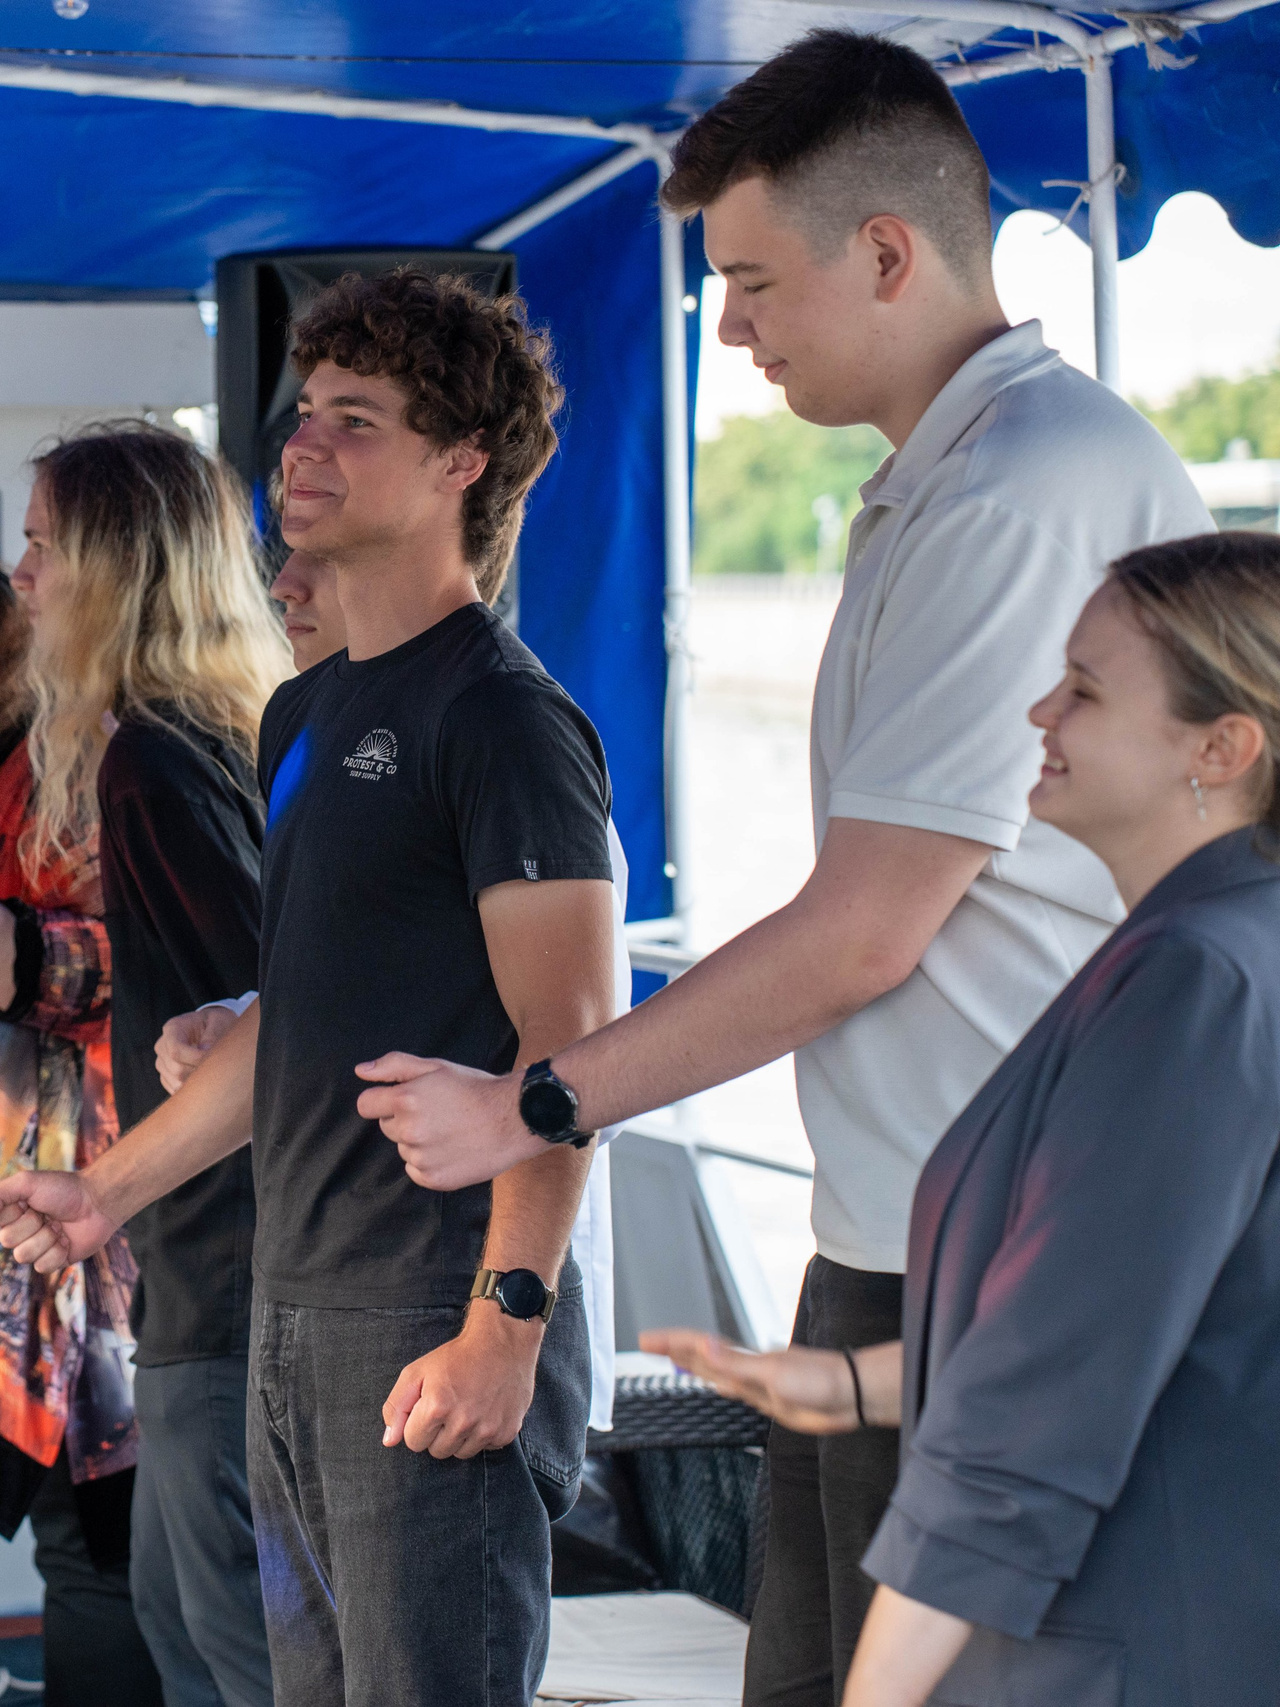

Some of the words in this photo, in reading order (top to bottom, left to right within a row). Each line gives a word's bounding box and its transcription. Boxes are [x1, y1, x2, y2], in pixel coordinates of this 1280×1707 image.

[342, 756, 375, 771] PROTEST
[376, 763, 384, 773] &
[386, 765, 397, 774] CO
[361, 772, 381, 781] SUPPLY
